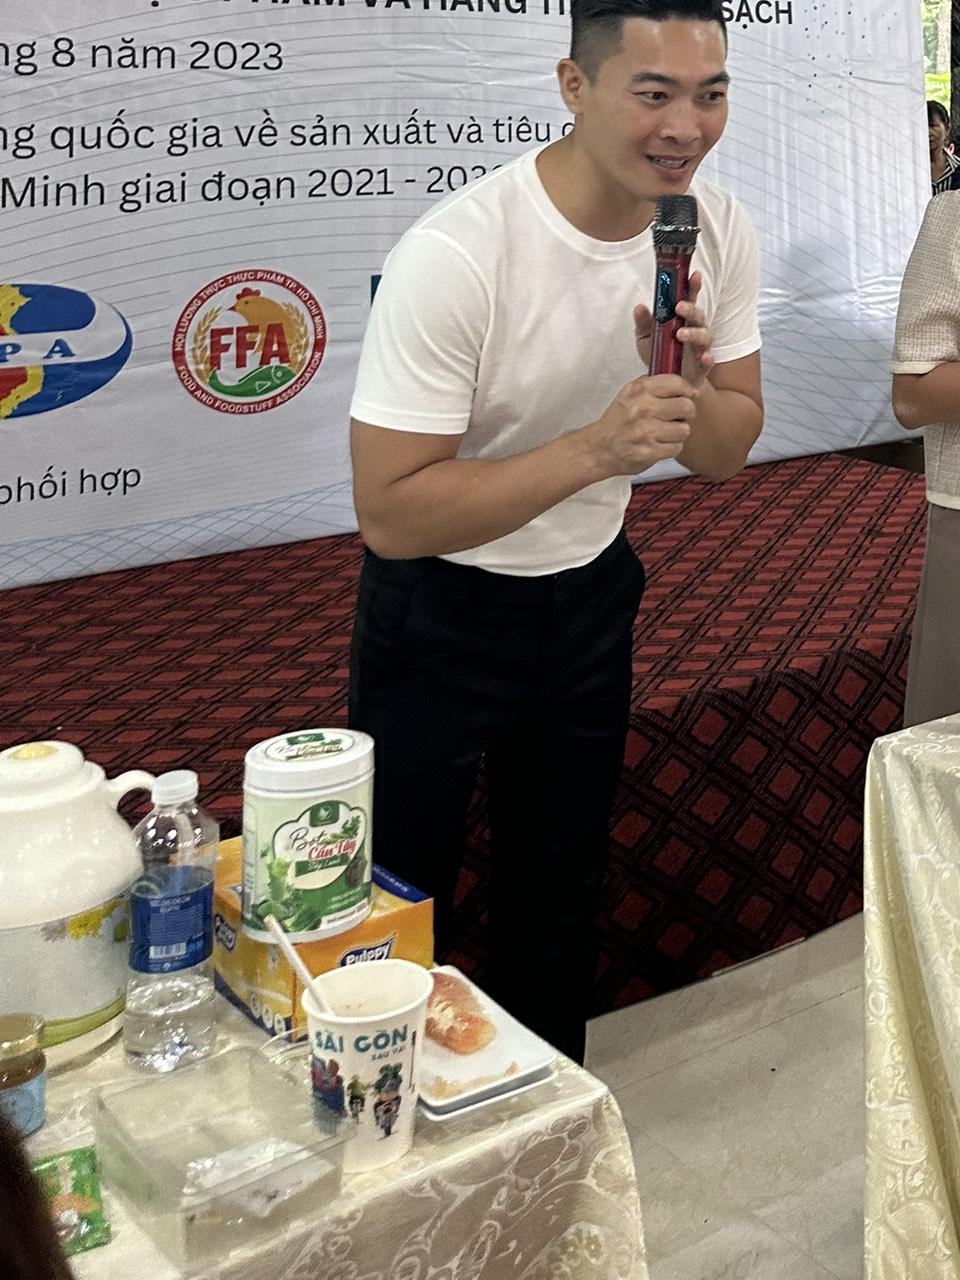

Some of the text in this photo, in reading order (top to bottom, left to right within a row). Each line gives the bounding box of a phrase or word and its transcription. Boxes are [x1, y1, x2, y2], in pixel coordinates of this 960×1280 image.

[52, 37, 76, 67] 8
[91, 37, 176, 69] năm
[189, 40, 284, 70] 2023
[50, 108, 155, 158] quốc
[167, 117, 223, 156] gia
[234, 108, 279, 147] về
[289, 114, 351, 146] sản
[363, 108, 437, 145] xuất
[447, 115, 484, 144] và
[492, 115, 551, 143] tiêu
[1, 174, 105, 208] Minh
[119, 172, 187, 213] giai
[201, 171, 296, 206] đoạn
[308, 168, 394, 197] 2021
[210, 322, 291, 370] FFA
[178, 352, 322, 413] FOOD AND FOODSTUFF ASSOCIATION
[79, 468, 141, 496] hợp
[346, 941, 390, 965] Pulppy
